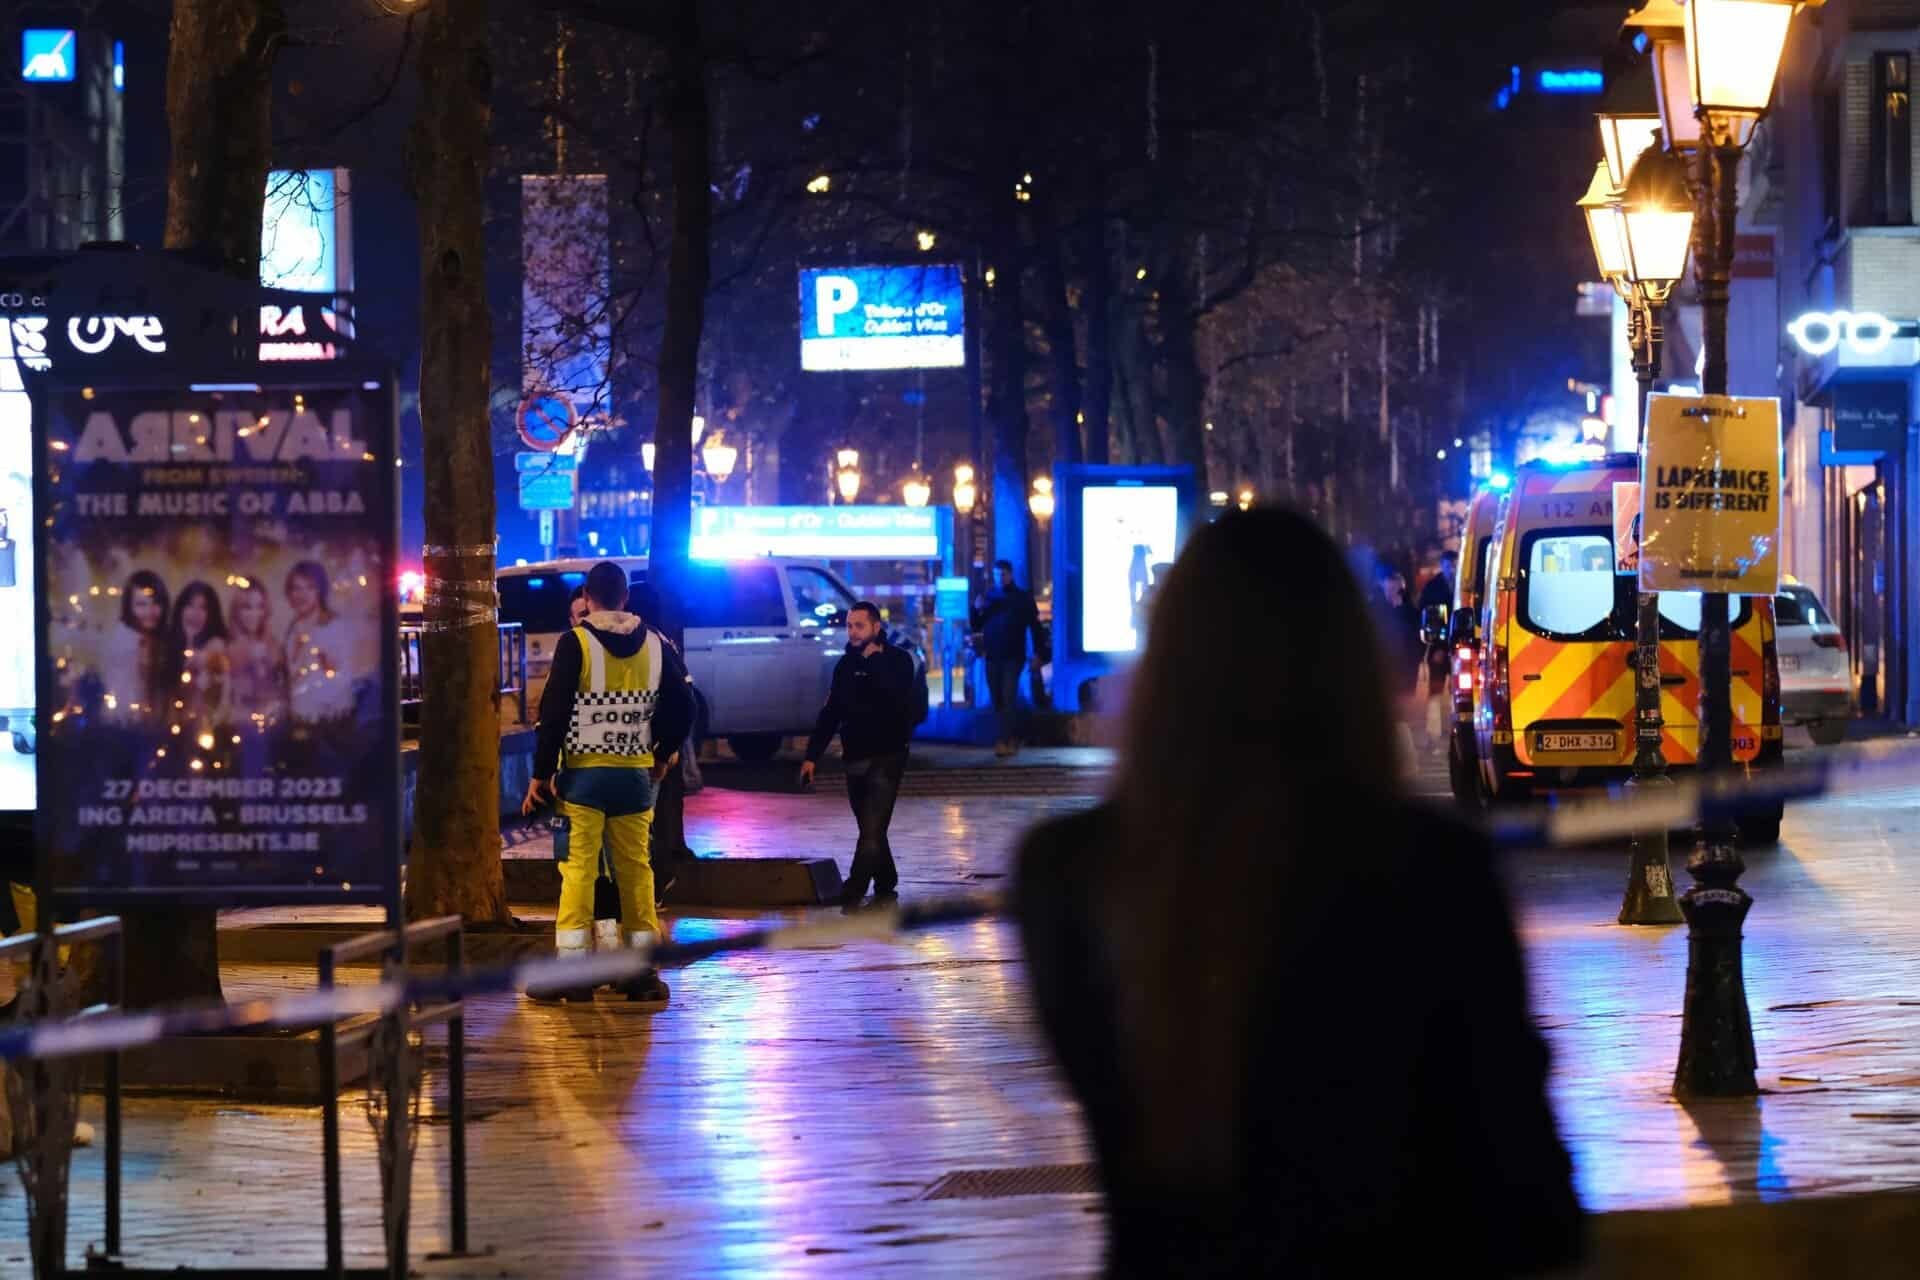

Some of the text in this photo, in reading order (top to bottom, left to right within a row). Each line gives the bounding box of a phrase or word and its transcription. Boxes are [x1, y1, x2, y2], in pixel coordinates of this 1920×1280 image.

[815, 276, 859, 336] P
[77, 491, 366, 516] THE MUSIC OF ABBA
[1542, 502, 1575, 518] 112
[1655, 492, 1769, 512] IS DIFFERENT
[603, 731, 641, 744] CRK
[102, 777, 343, 798] 27 DECEMBER 2023
[78, 807, 122, 824] ING
[130, 806, 217, 824] ARENA
[240, 803, 368, 823] BRUSSELS
